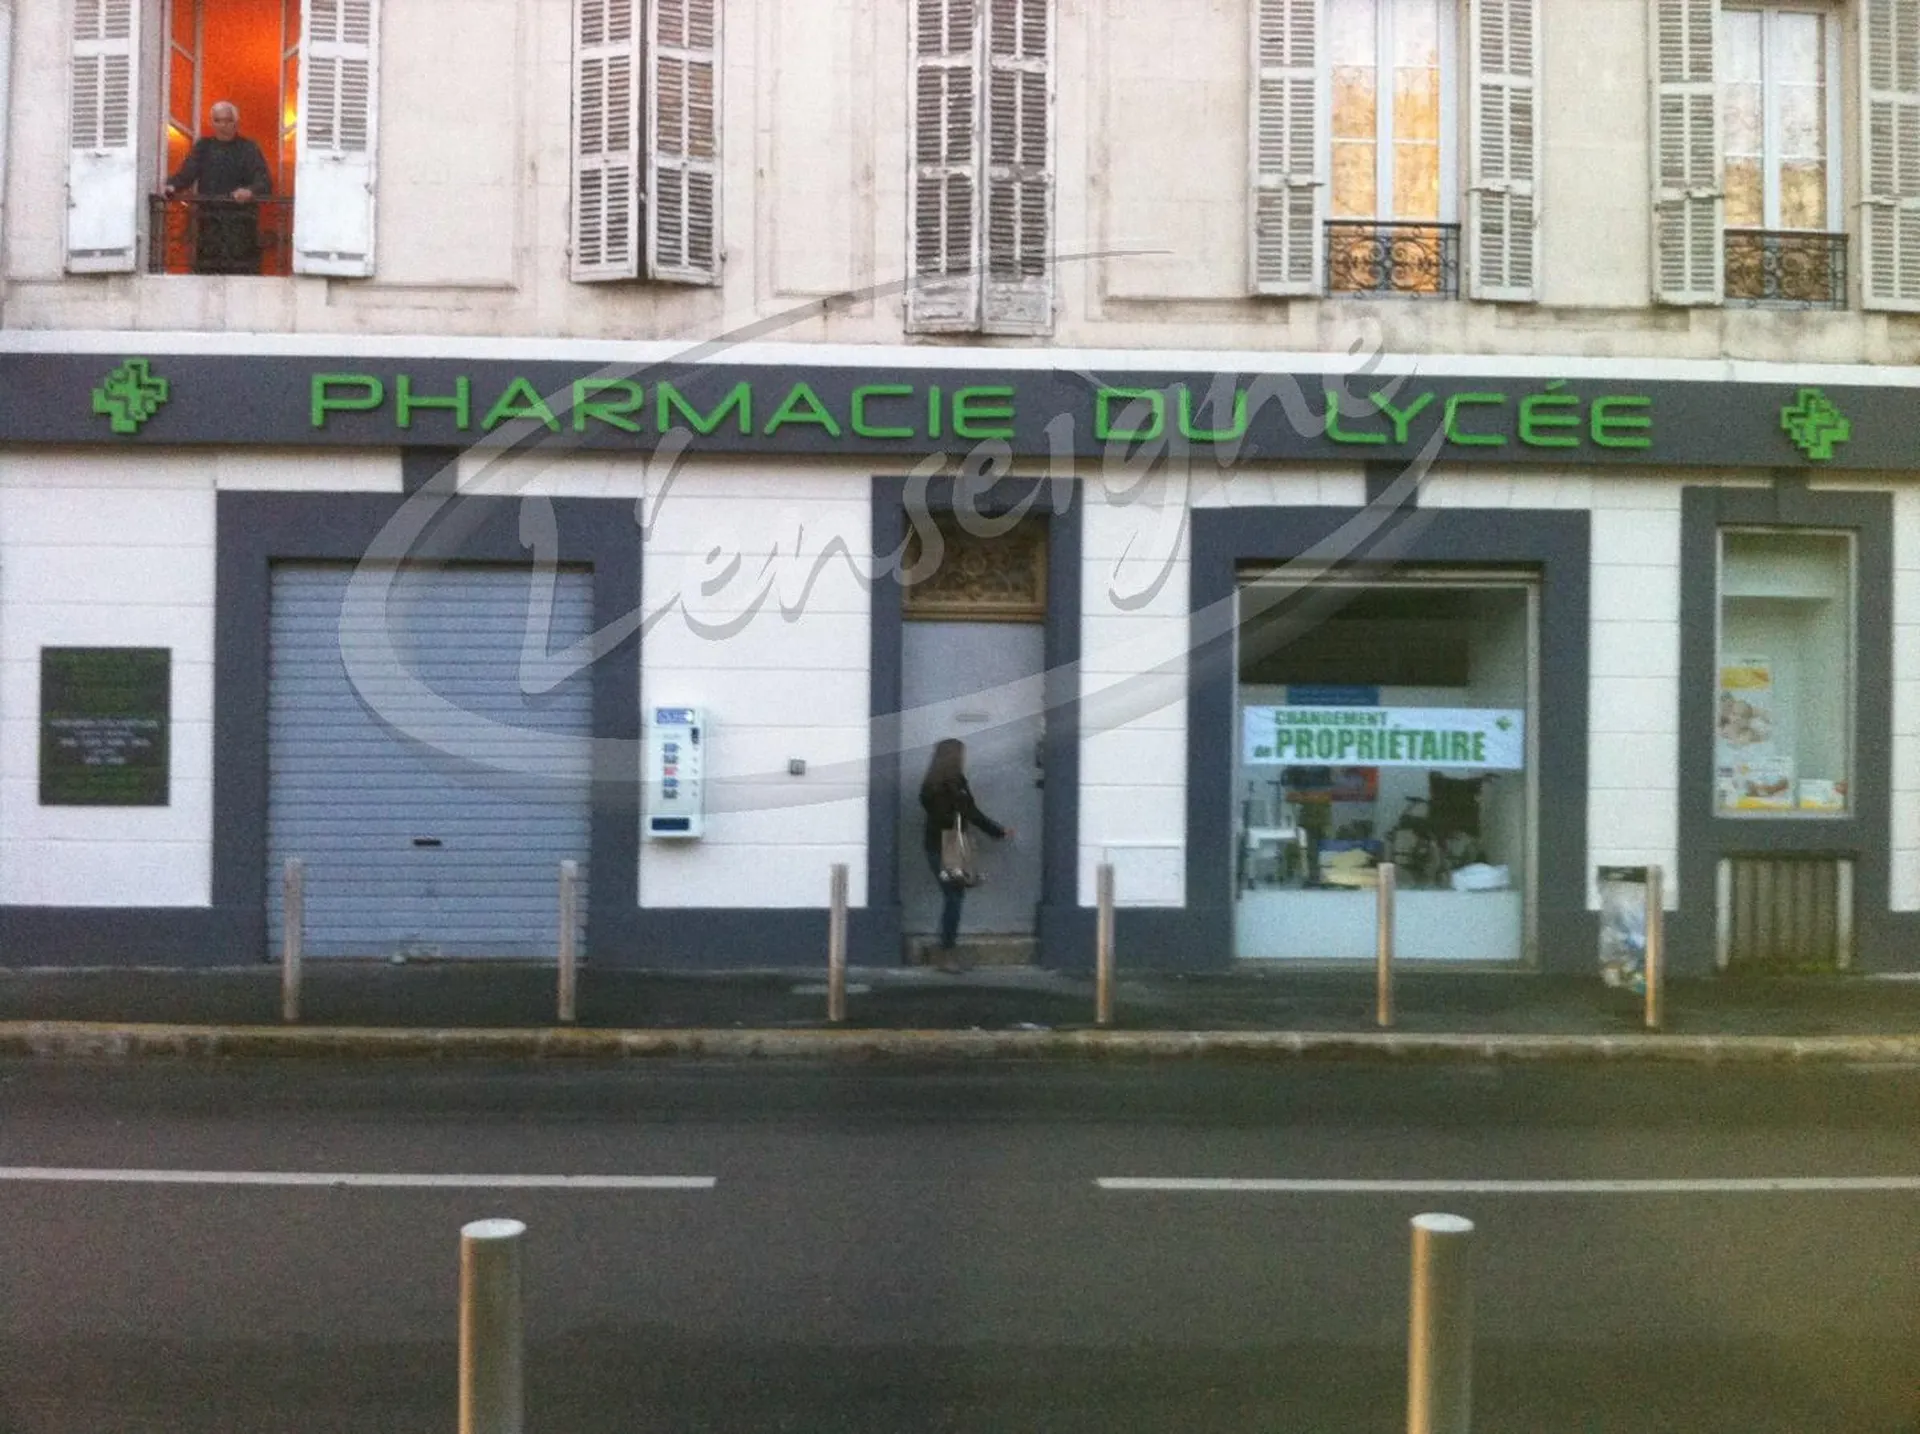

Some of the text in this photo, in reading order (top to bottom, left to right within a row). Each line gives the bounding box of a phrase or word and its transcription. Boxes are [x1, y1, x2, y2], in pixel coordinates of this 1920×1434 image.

[309, 373, 1654, 449] PHARMACIE DU LYCÉE
[1275, 710, 1388, 727] CHANGEMENT
[1276, 724, 1486, 762] PROPRIÉTAIRE
